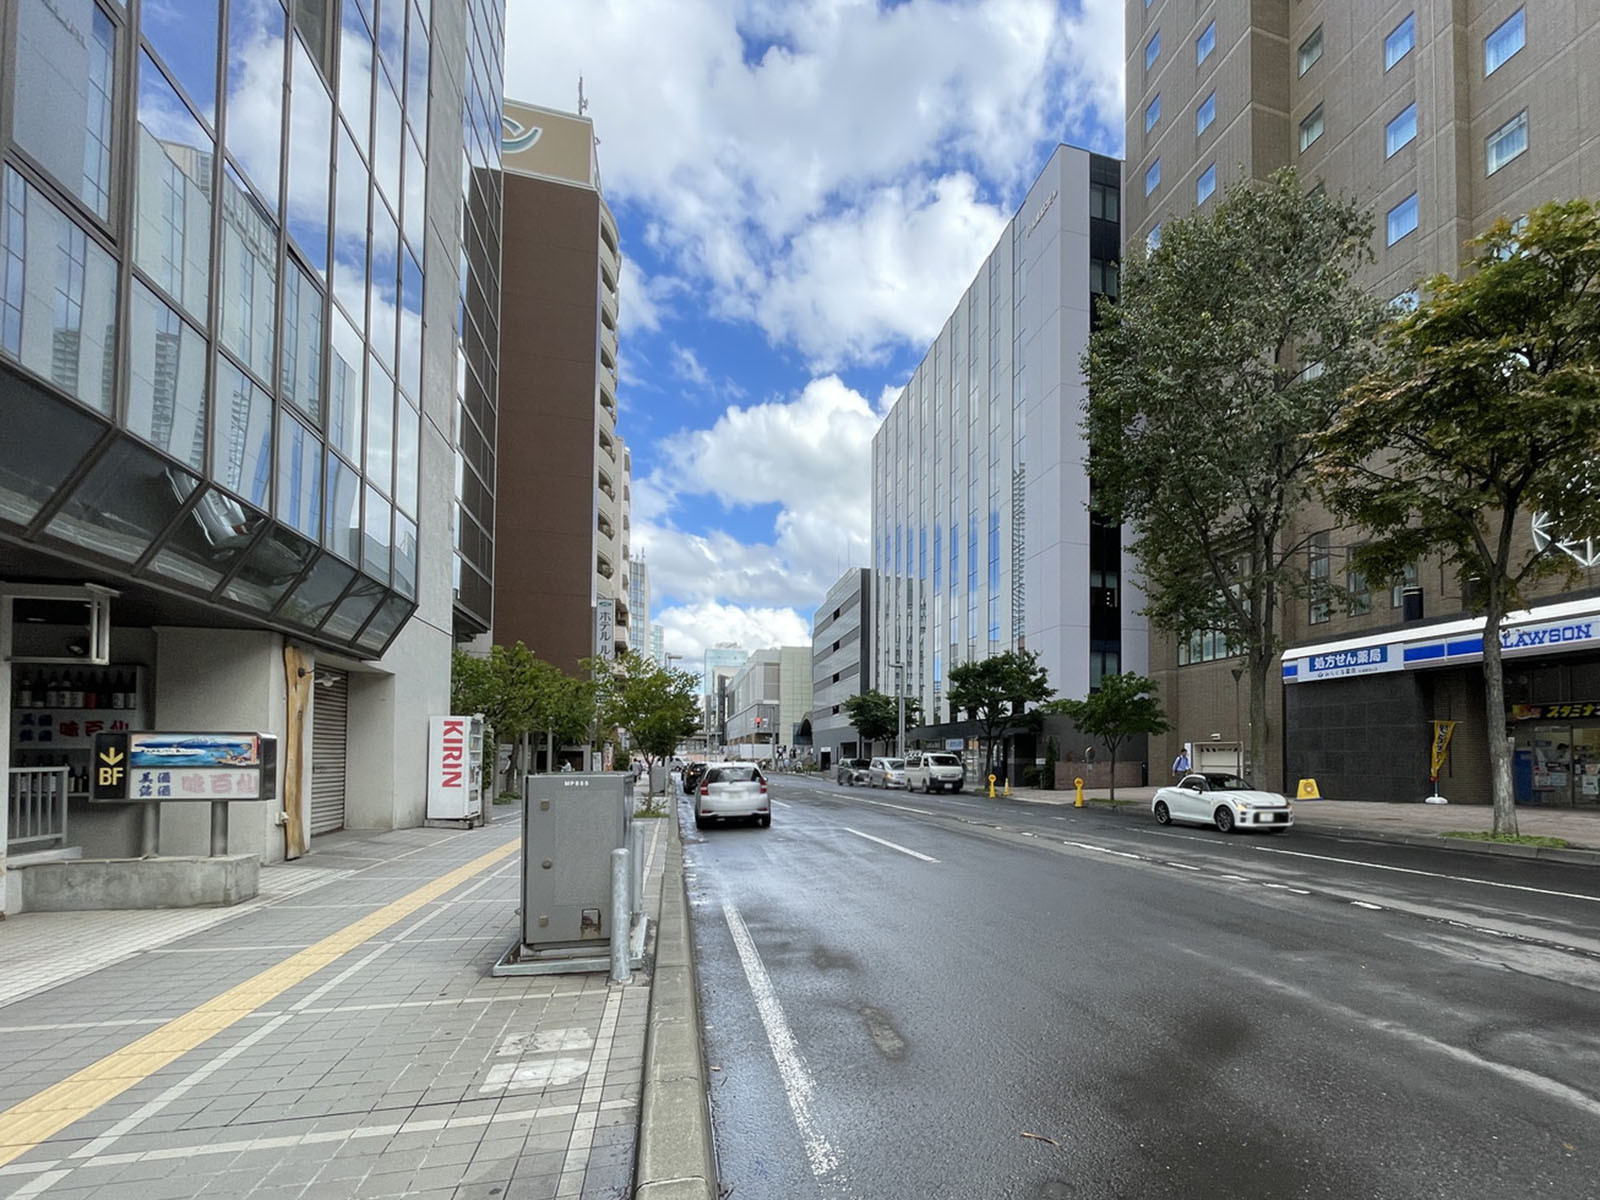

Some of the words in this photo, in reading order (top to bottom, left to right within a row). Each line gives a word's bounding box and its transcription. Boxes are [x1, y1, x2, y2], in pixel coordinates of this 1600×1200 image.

[599, 611, 611, 641] ホテル
[1502, 624, 1592, 649] LAWSON
[1314, 649, 1381, 670] 処方せん薬局
[442, 720, 463, 788] KIRIN
[99, 767, 123, 786] BF
